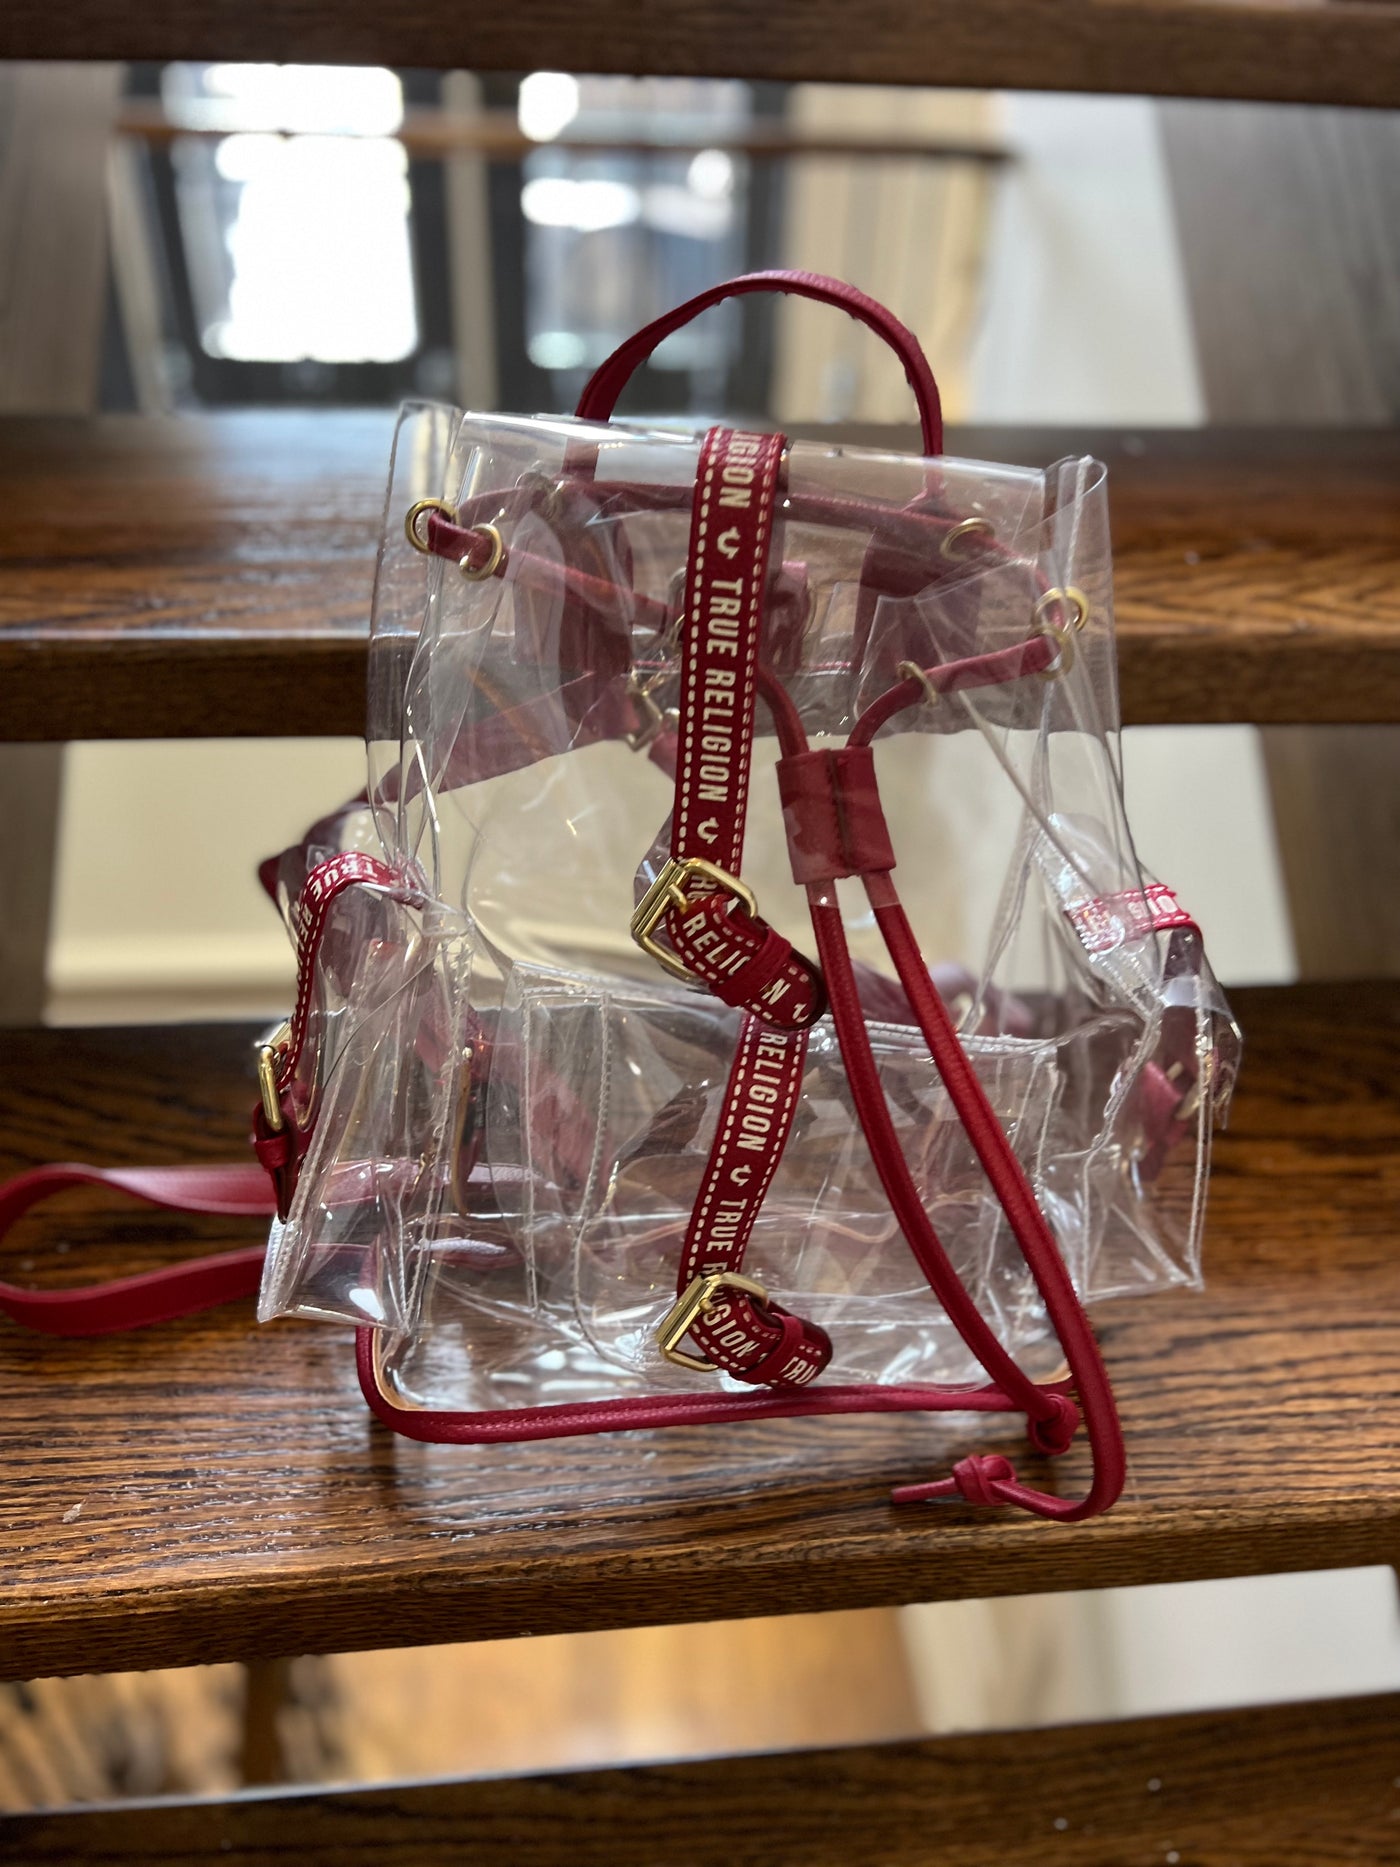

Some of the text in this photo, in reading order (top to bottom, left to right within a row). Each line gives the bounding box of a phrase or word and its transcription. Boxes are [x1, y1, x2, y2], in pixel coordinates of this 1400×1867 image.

[718, 431, 763, 509] IGION
[706, 577, 744, 657] TRUE
[697, 667, 736, 802] RELIGION
[736, 1031, 787, 1152] RELIGION
[706, 1198, 748, 1253] TRUE
